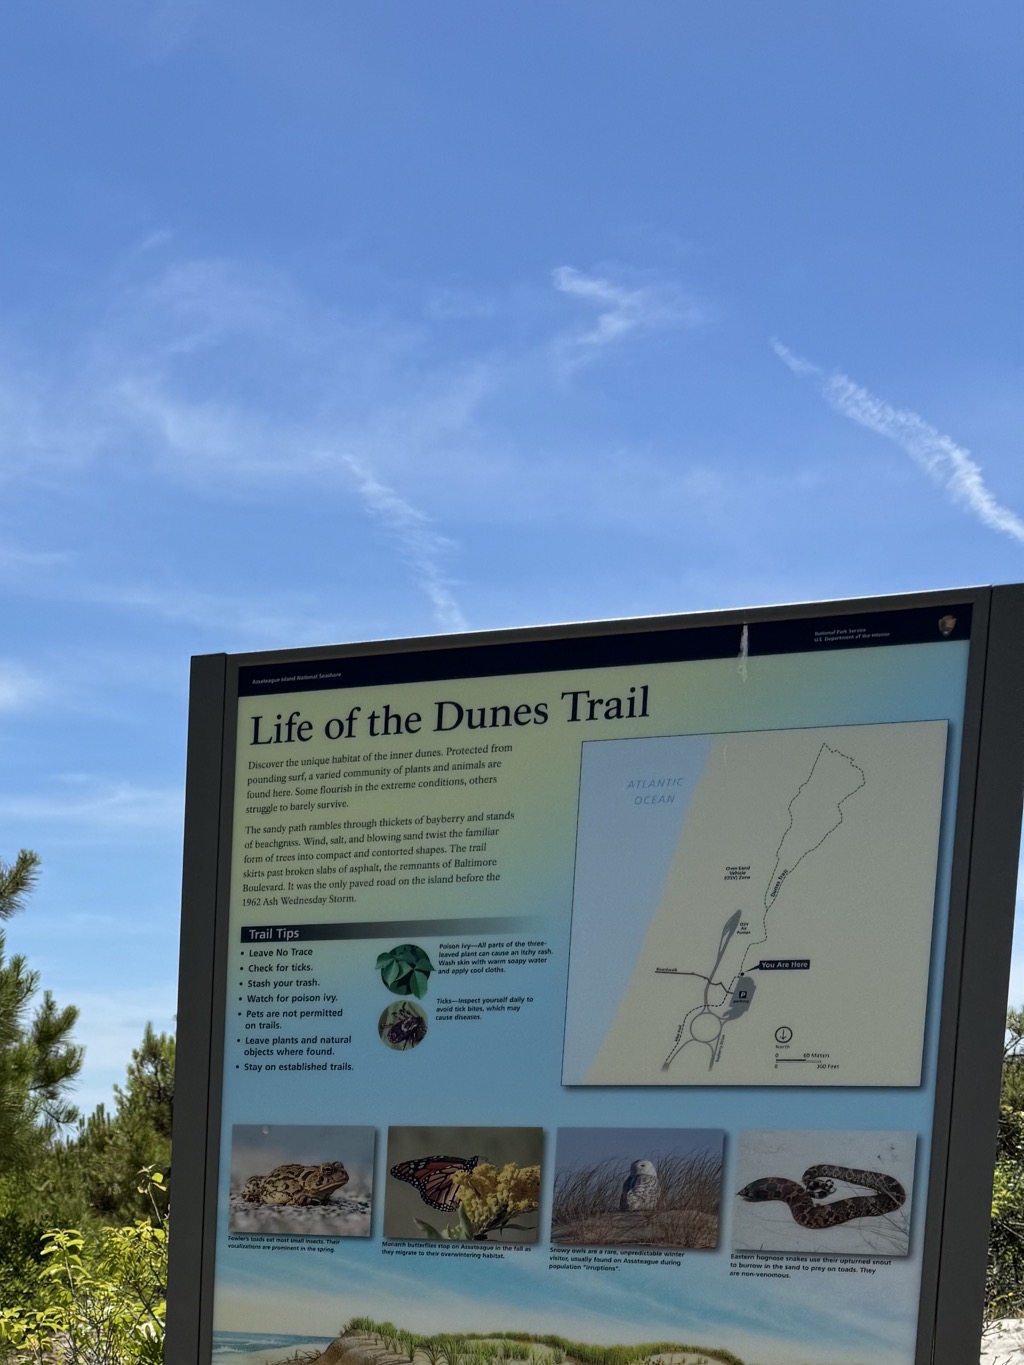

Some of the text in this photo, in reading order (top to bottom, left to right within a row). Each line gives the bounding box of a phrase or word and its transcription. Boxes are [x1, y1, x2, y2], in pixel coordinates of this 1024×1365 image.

[250, 685, 650, 745] Life of the Dunes Trail
[248, 761, 283, 769] Discover
[286, 758, 298, 766] the
[301, 757, 329, 766] unique
[332, 754, 360, 763] habitat
[362, 752, 371, 761] of
[374, 752, 387, 760] the
[414, 749, 443, 757] dunes.
[446, 744, 488, 755] Protected
[491, 744, 513, 752] from
[247, 774, 286, 785] pounding
[288, 771, 306, 781] surf,
[315, 769, 340, 779] varied
[343, 767, 390, 777] community
[393, 765, 401, 774] of
[404, 765, 430, 775] plants
[432, 762, 449, 771] and
[451, 760, 485, 770] animals
[246, 789, 270, 798] found
[272, 788, 292, 797] here.
[295, 787, 317, 795] Some
[320, 784, 352, 793] flourish
[365, 782, 378, 791] the
[417, 778, 466, 787] conditions,
[469, 775, 497, 784] others
[627, 778, 685, 789] ATLANTIC
[634, 795, 675, 805] OCEAN
[246, 803, 277, 814] struggle
[290, 801, 314, 811] barely
[316, 800, 348, 808] survive.
[245, 811, 514, 834] The sandy path rambles through thickets of bayberry and stands
[244, 827, 499, 849] of beachgrass. Wind, salt, and blowing sand twist the familiar
[244, 854, 262, 863] form
[265, 853, 273, 862] of
[316, 851, 350, 860] compact
[353, 848, 369, 857] and
[371, 846, 413, 856] contorted
[415, 846, 446, 856] shapes.
[451, 844, 466, 852] The
[469, 842, 487, 851] trail
[249, 928, 300, 941] Trail Tips
[248, 964, 272, 972] Check
[291, 963, 313, 971] ticks.
[273, 980, 292, 988] your
[276, 994, 288, 1002] for
[291, 994, 320, 1003] poison
[323, 993, 338, 1003] ivy.
[299, 1008, 343, 1018] permitted
[272, 1036, 298, 1045] plants
[301, 1035, 317, 1043] and
[244, 1048, 273, 1057] objects
[306, 1047, 334, 1055] found.
[244, 1063, 262, 1072] Stay
